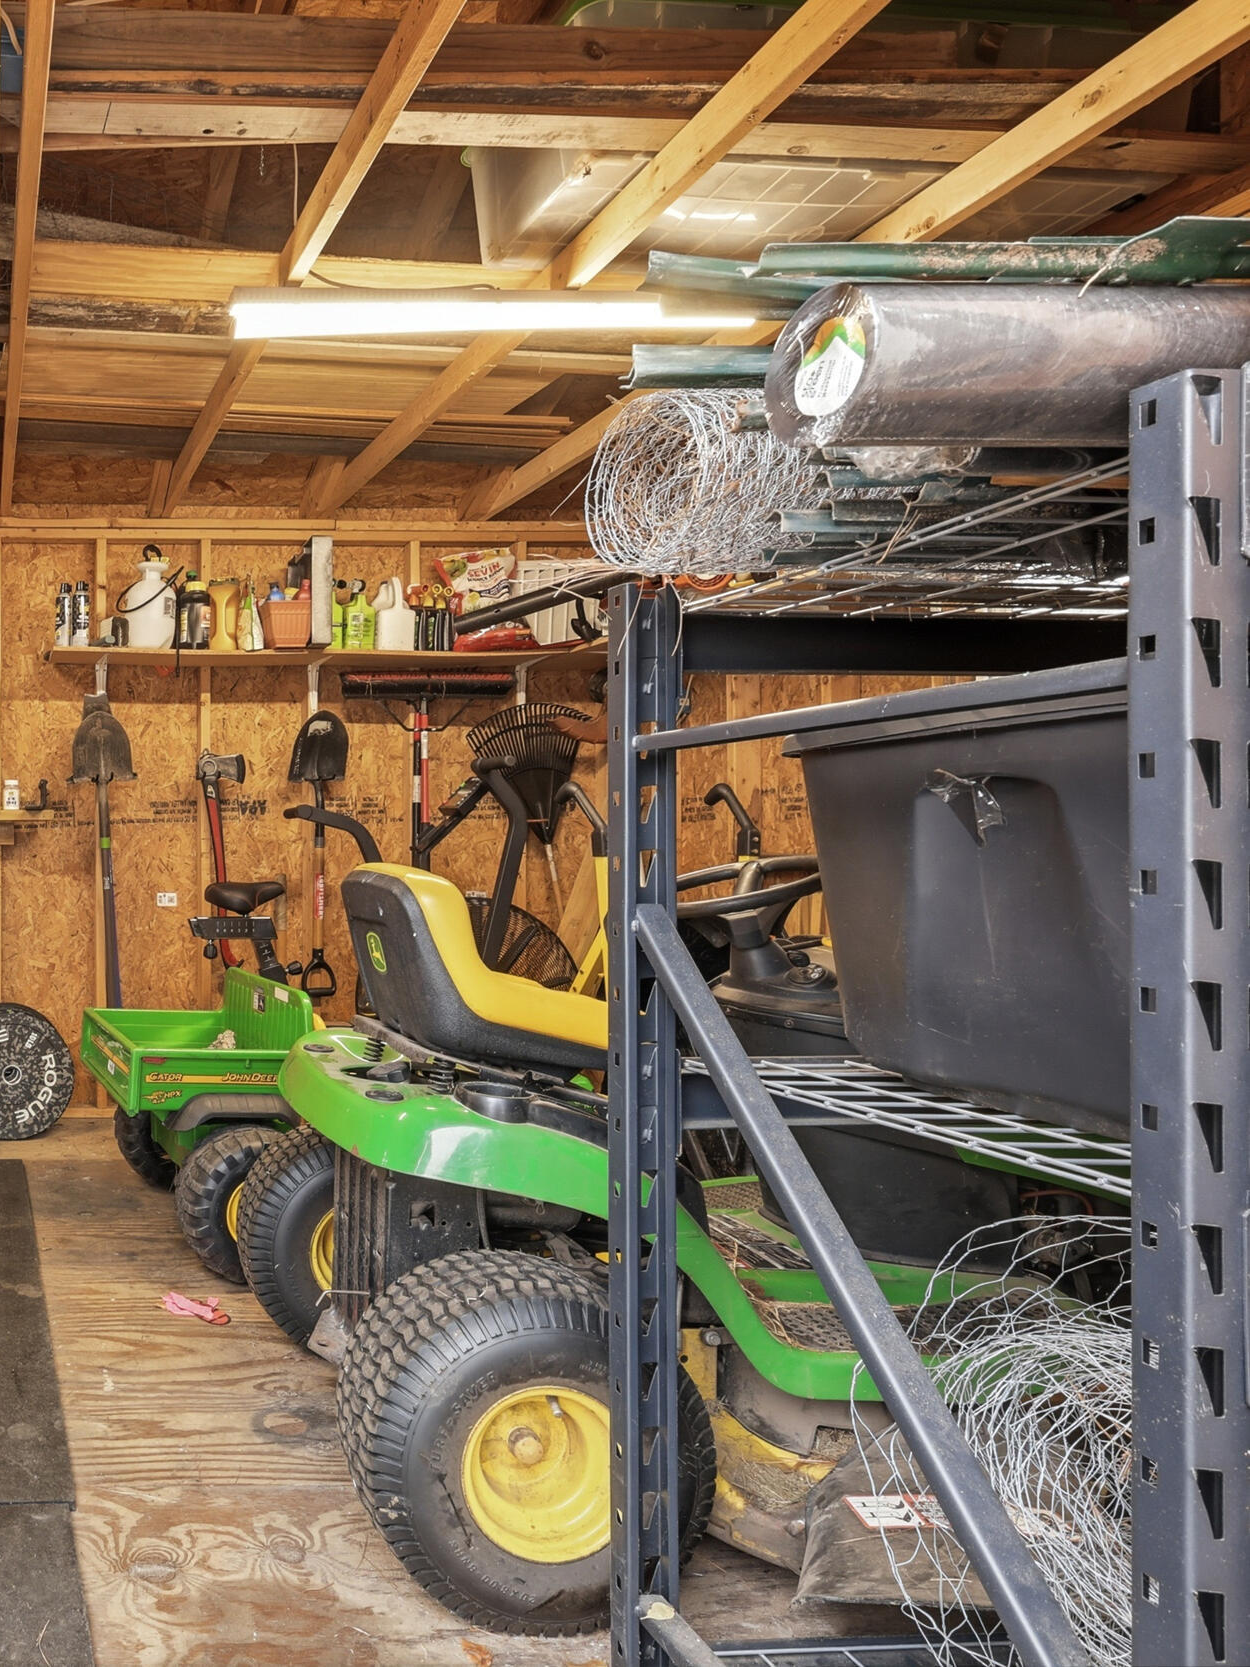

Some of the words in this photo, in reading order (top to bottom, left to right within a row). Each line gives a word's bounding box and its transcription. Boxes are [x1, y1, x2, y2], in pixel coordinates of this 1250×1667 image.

[467, 562, 500, 578] SEVIN
[150, 1072, 183, 1082] GATOR
[222, 1072, 251, 1083] JOHN
[251, 1072, 278, 1082] DEE
[14, 1053, 57, 1124] ROGUE
